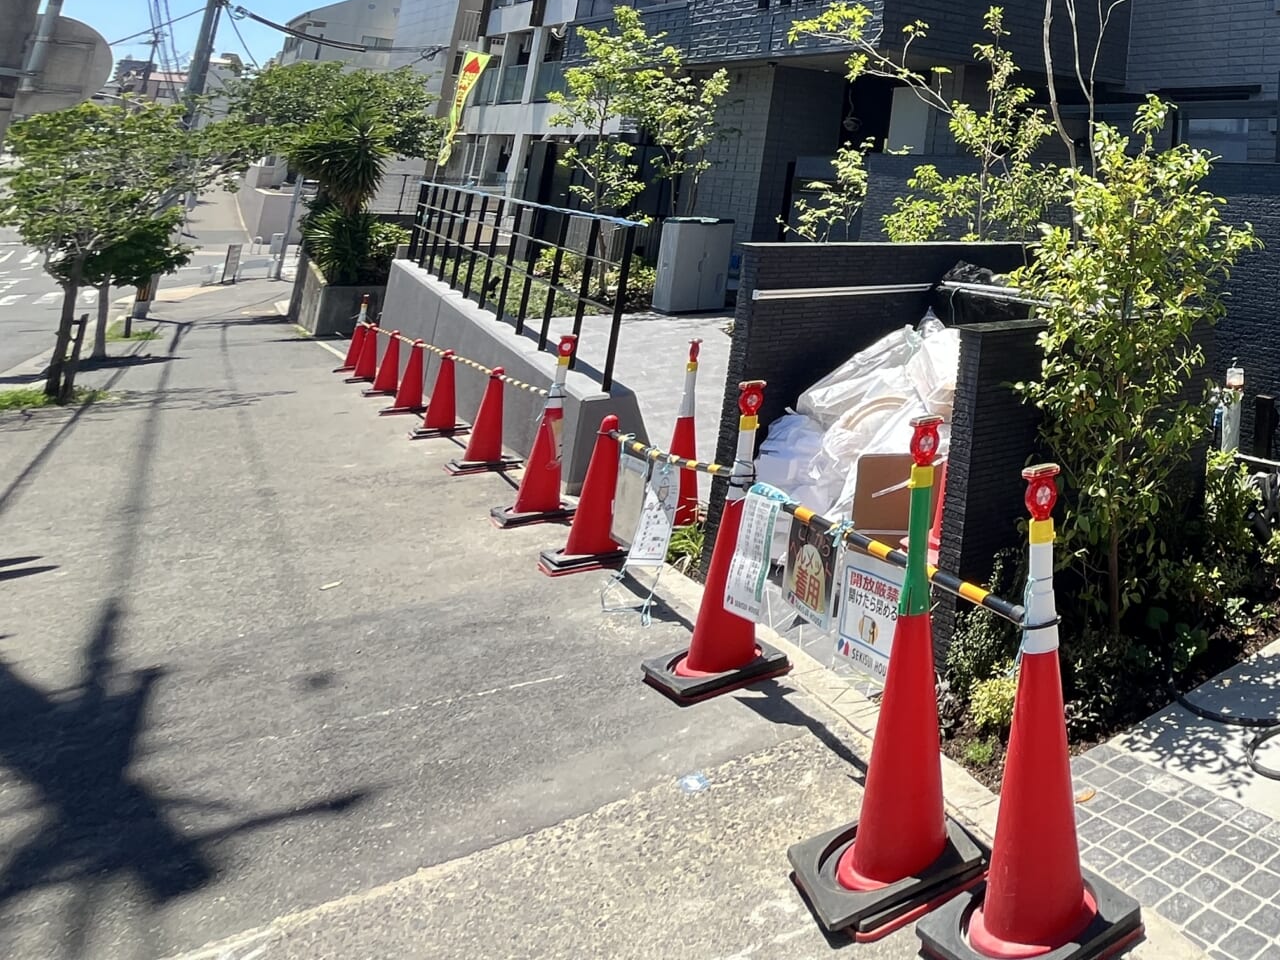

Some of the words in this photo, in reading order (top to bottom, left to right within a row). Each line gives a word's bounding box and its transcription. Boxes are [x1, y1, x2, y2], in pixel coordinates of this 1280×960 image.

[795, 565, 821, 610] 着用
[849, 571, 900, 603] 開放厳禁
[848, 587, 898, 621] 開けたら閉める
[851, 648, 873, 669] SEKISUI
[873, 662, 887, 677] HOU
